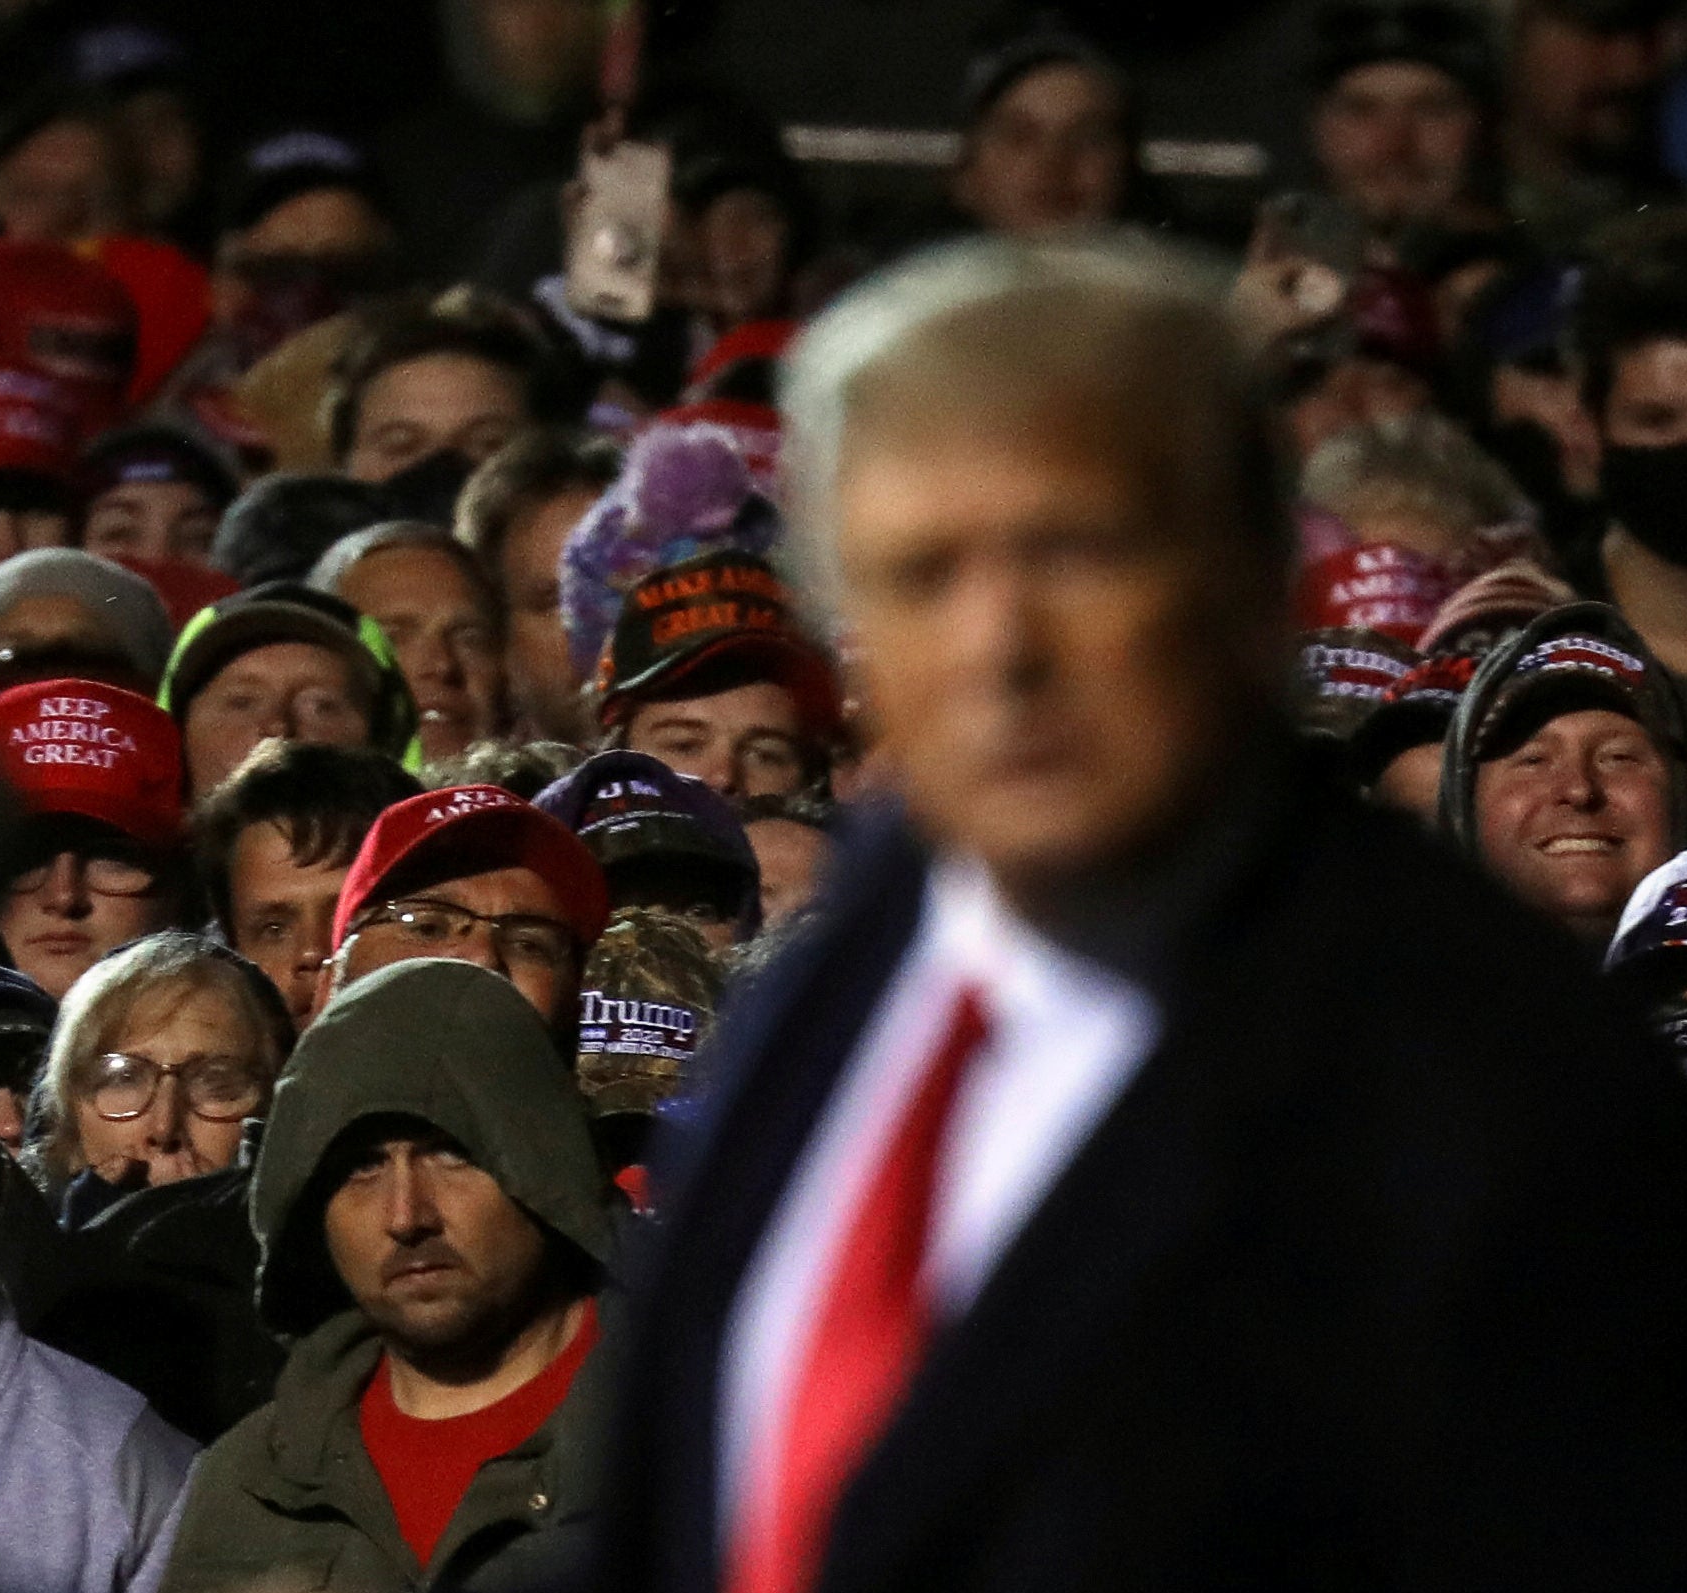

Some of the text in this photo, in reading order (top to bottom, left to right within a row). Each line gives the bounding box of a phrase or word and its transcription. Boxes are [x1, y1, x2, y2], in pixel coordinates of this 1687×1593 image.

[39, 697, 112, 720] KEEP
[8, 719, 137, 752] AMERICA
[23, 744, 120, 769] GREAT
[579, 991, 695, 1042] Trump
[619, 1027, 664, 1043] 2020
